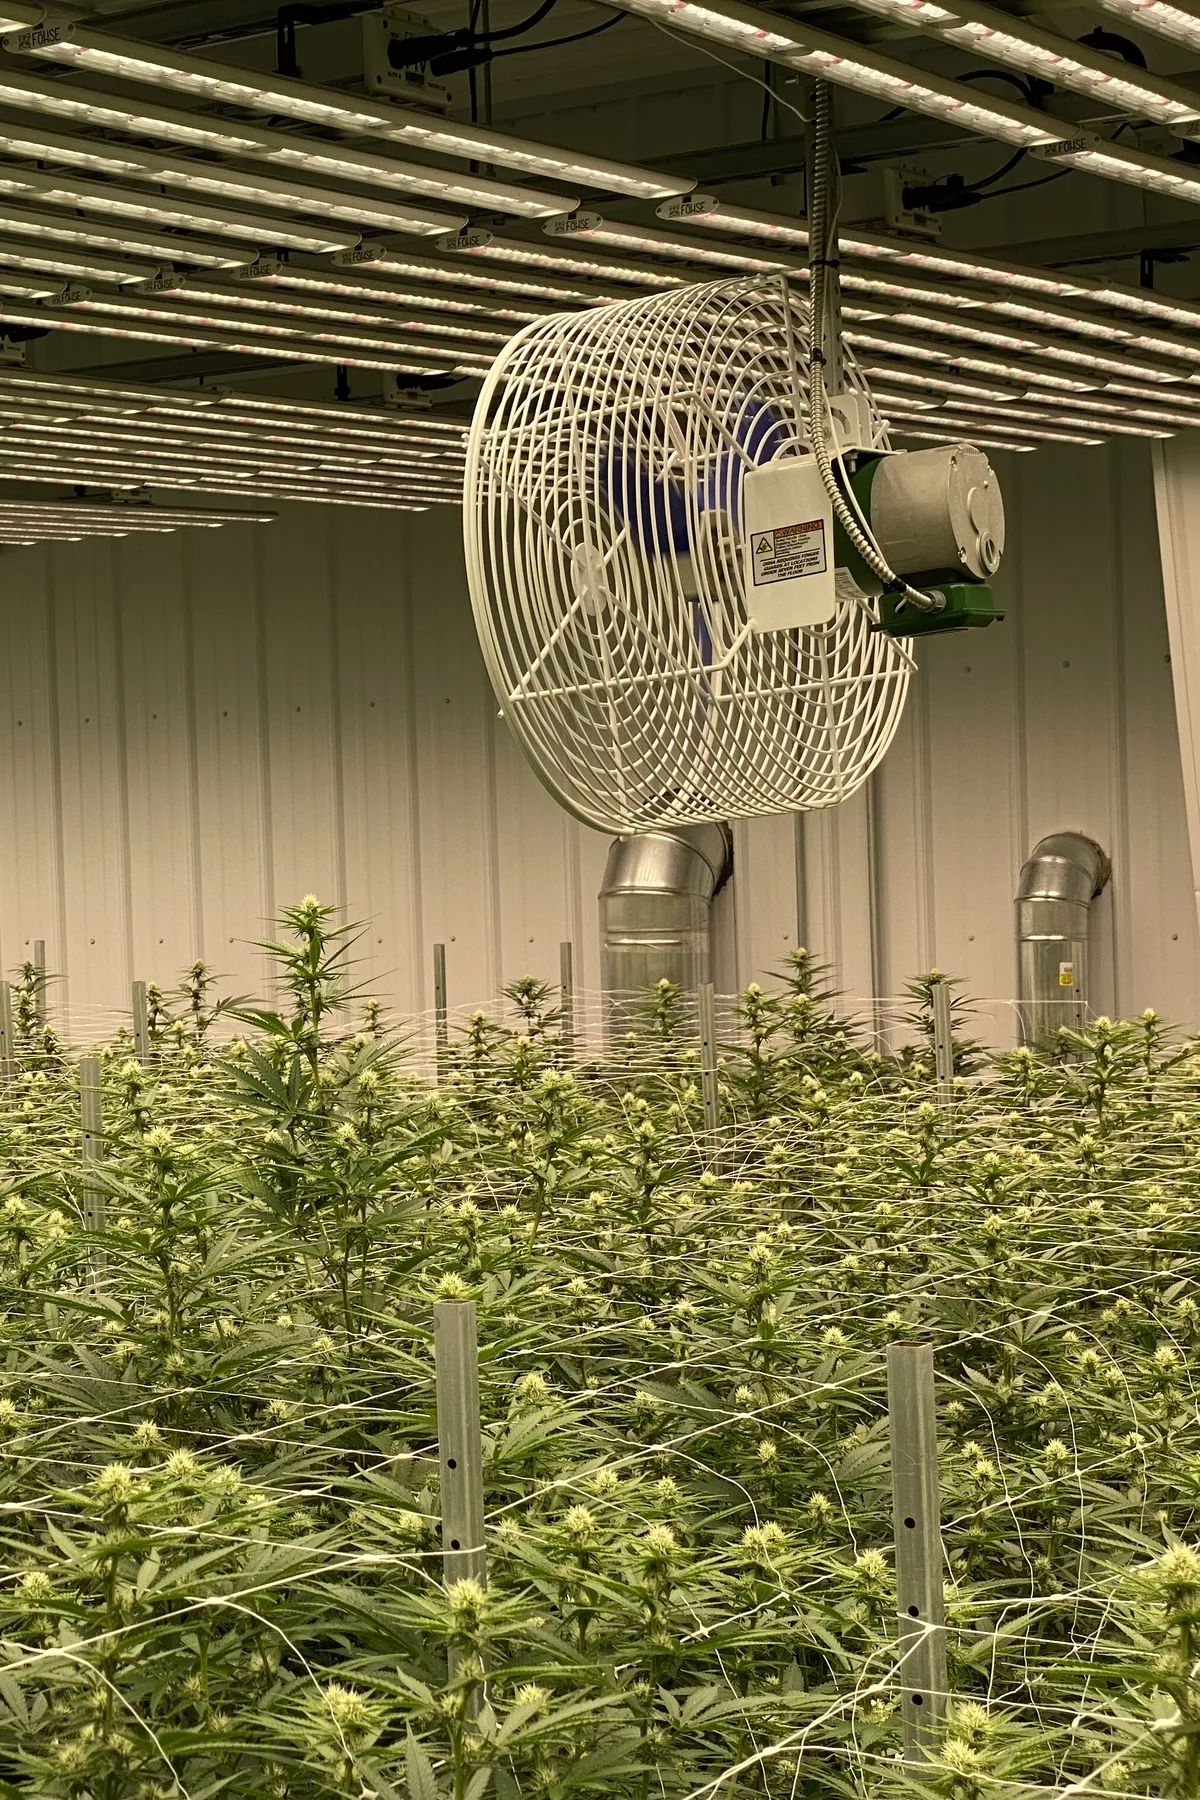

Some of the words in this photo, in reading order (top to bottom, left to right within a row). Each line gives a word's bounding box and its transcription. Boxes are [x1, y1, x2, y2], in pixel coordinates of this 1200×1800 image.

[781, 522, 820, 535] WARNING
[763, 563, 783, 571] GUARDS
[791, 556, 818, 566] LOCATIONS
[777, 554, 800, 564] REQUIRES
